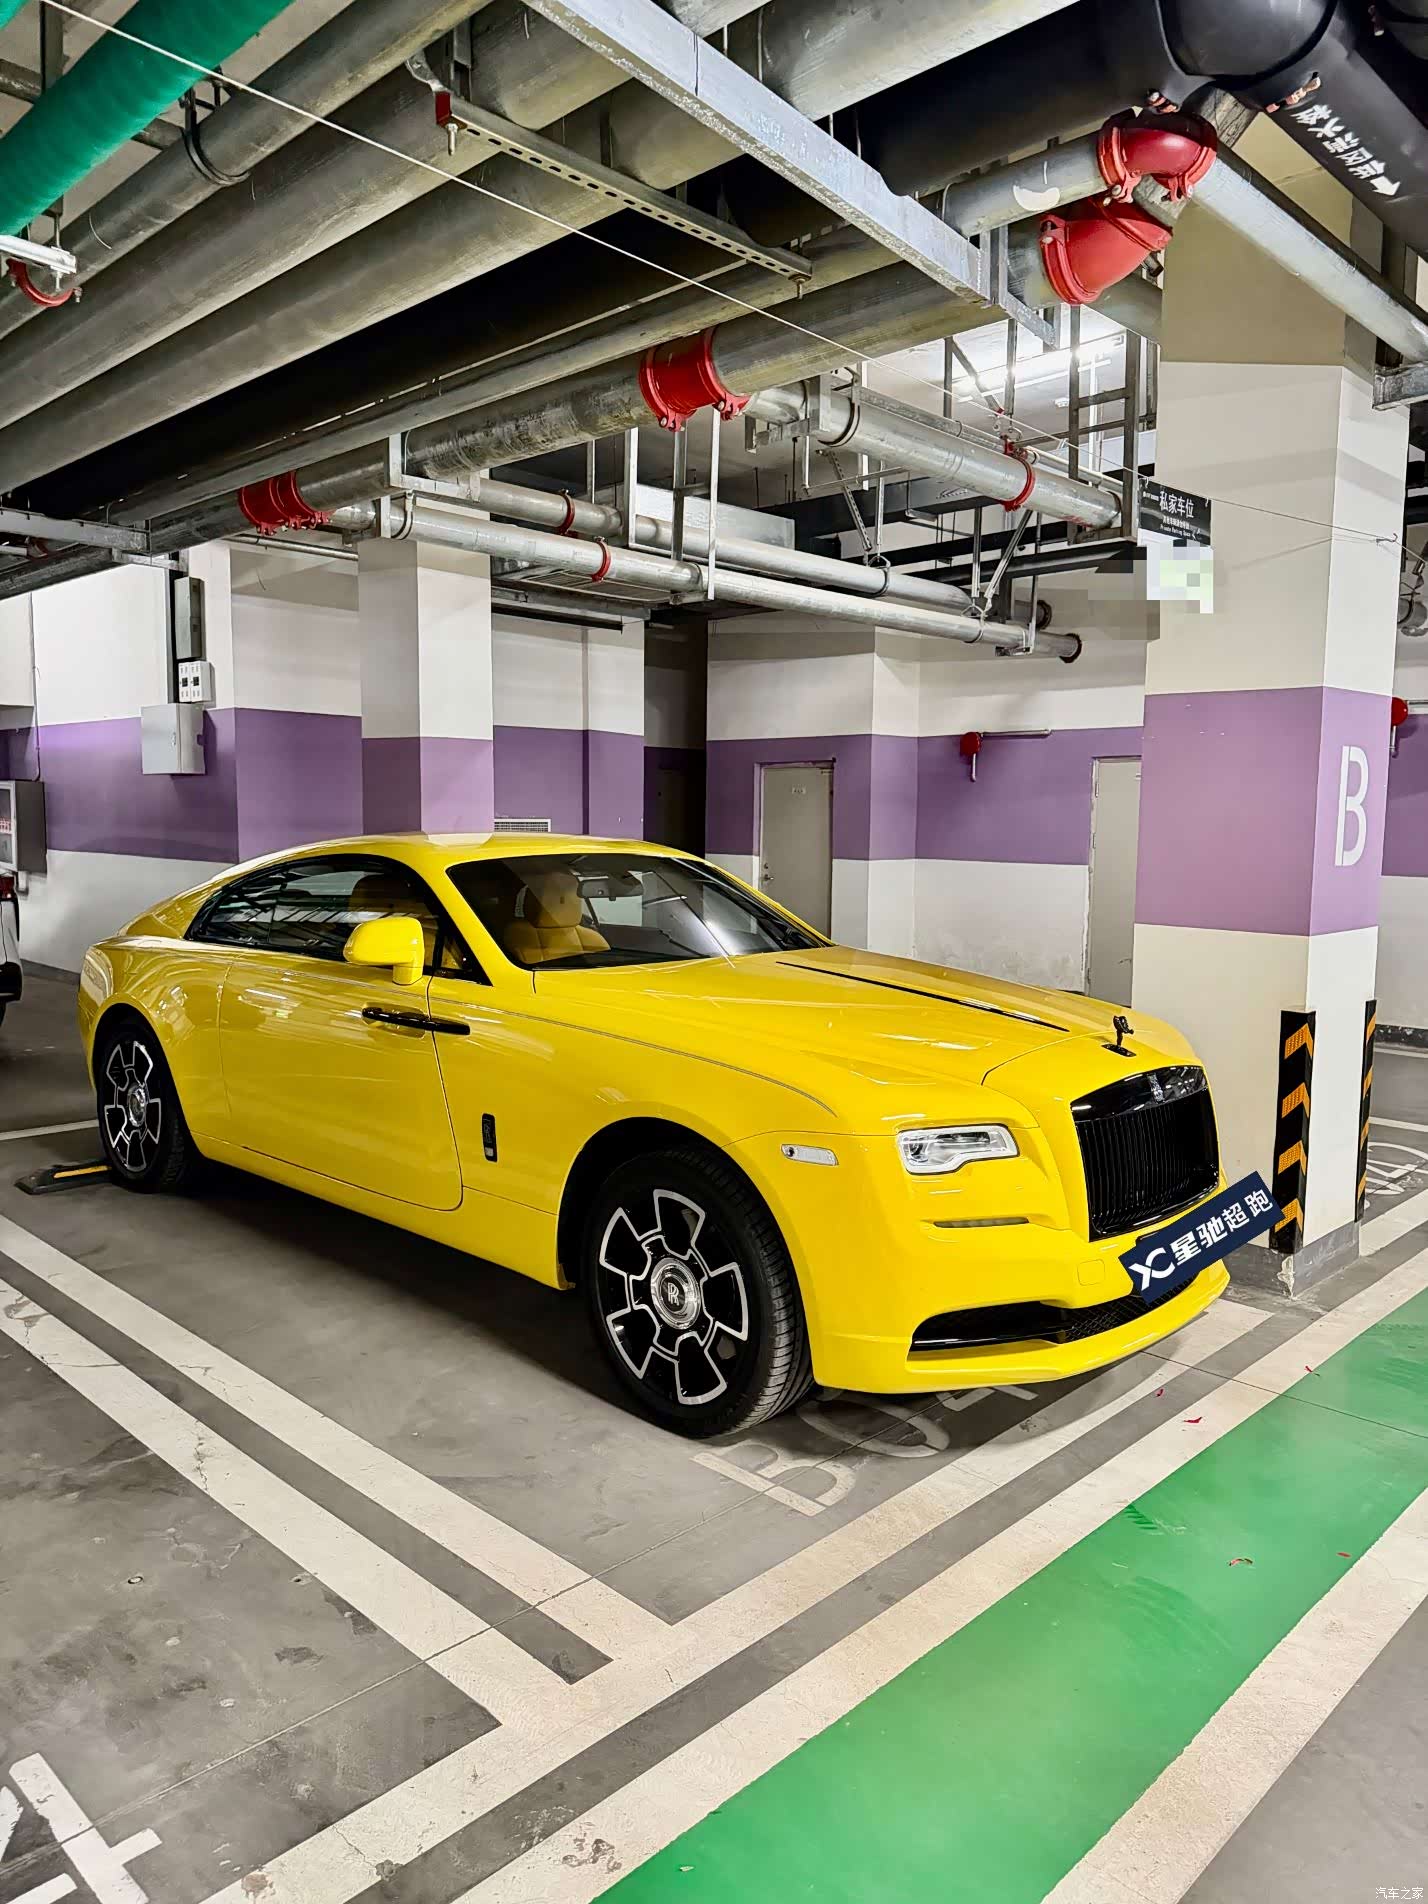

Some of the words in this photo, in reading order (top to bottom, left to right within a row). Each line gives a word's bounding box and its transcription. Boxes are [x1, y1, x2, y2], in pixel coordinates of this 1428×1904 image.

[1159, 490, 1194, 519] 私家车位
[1335, 745, 1369, 867] B
